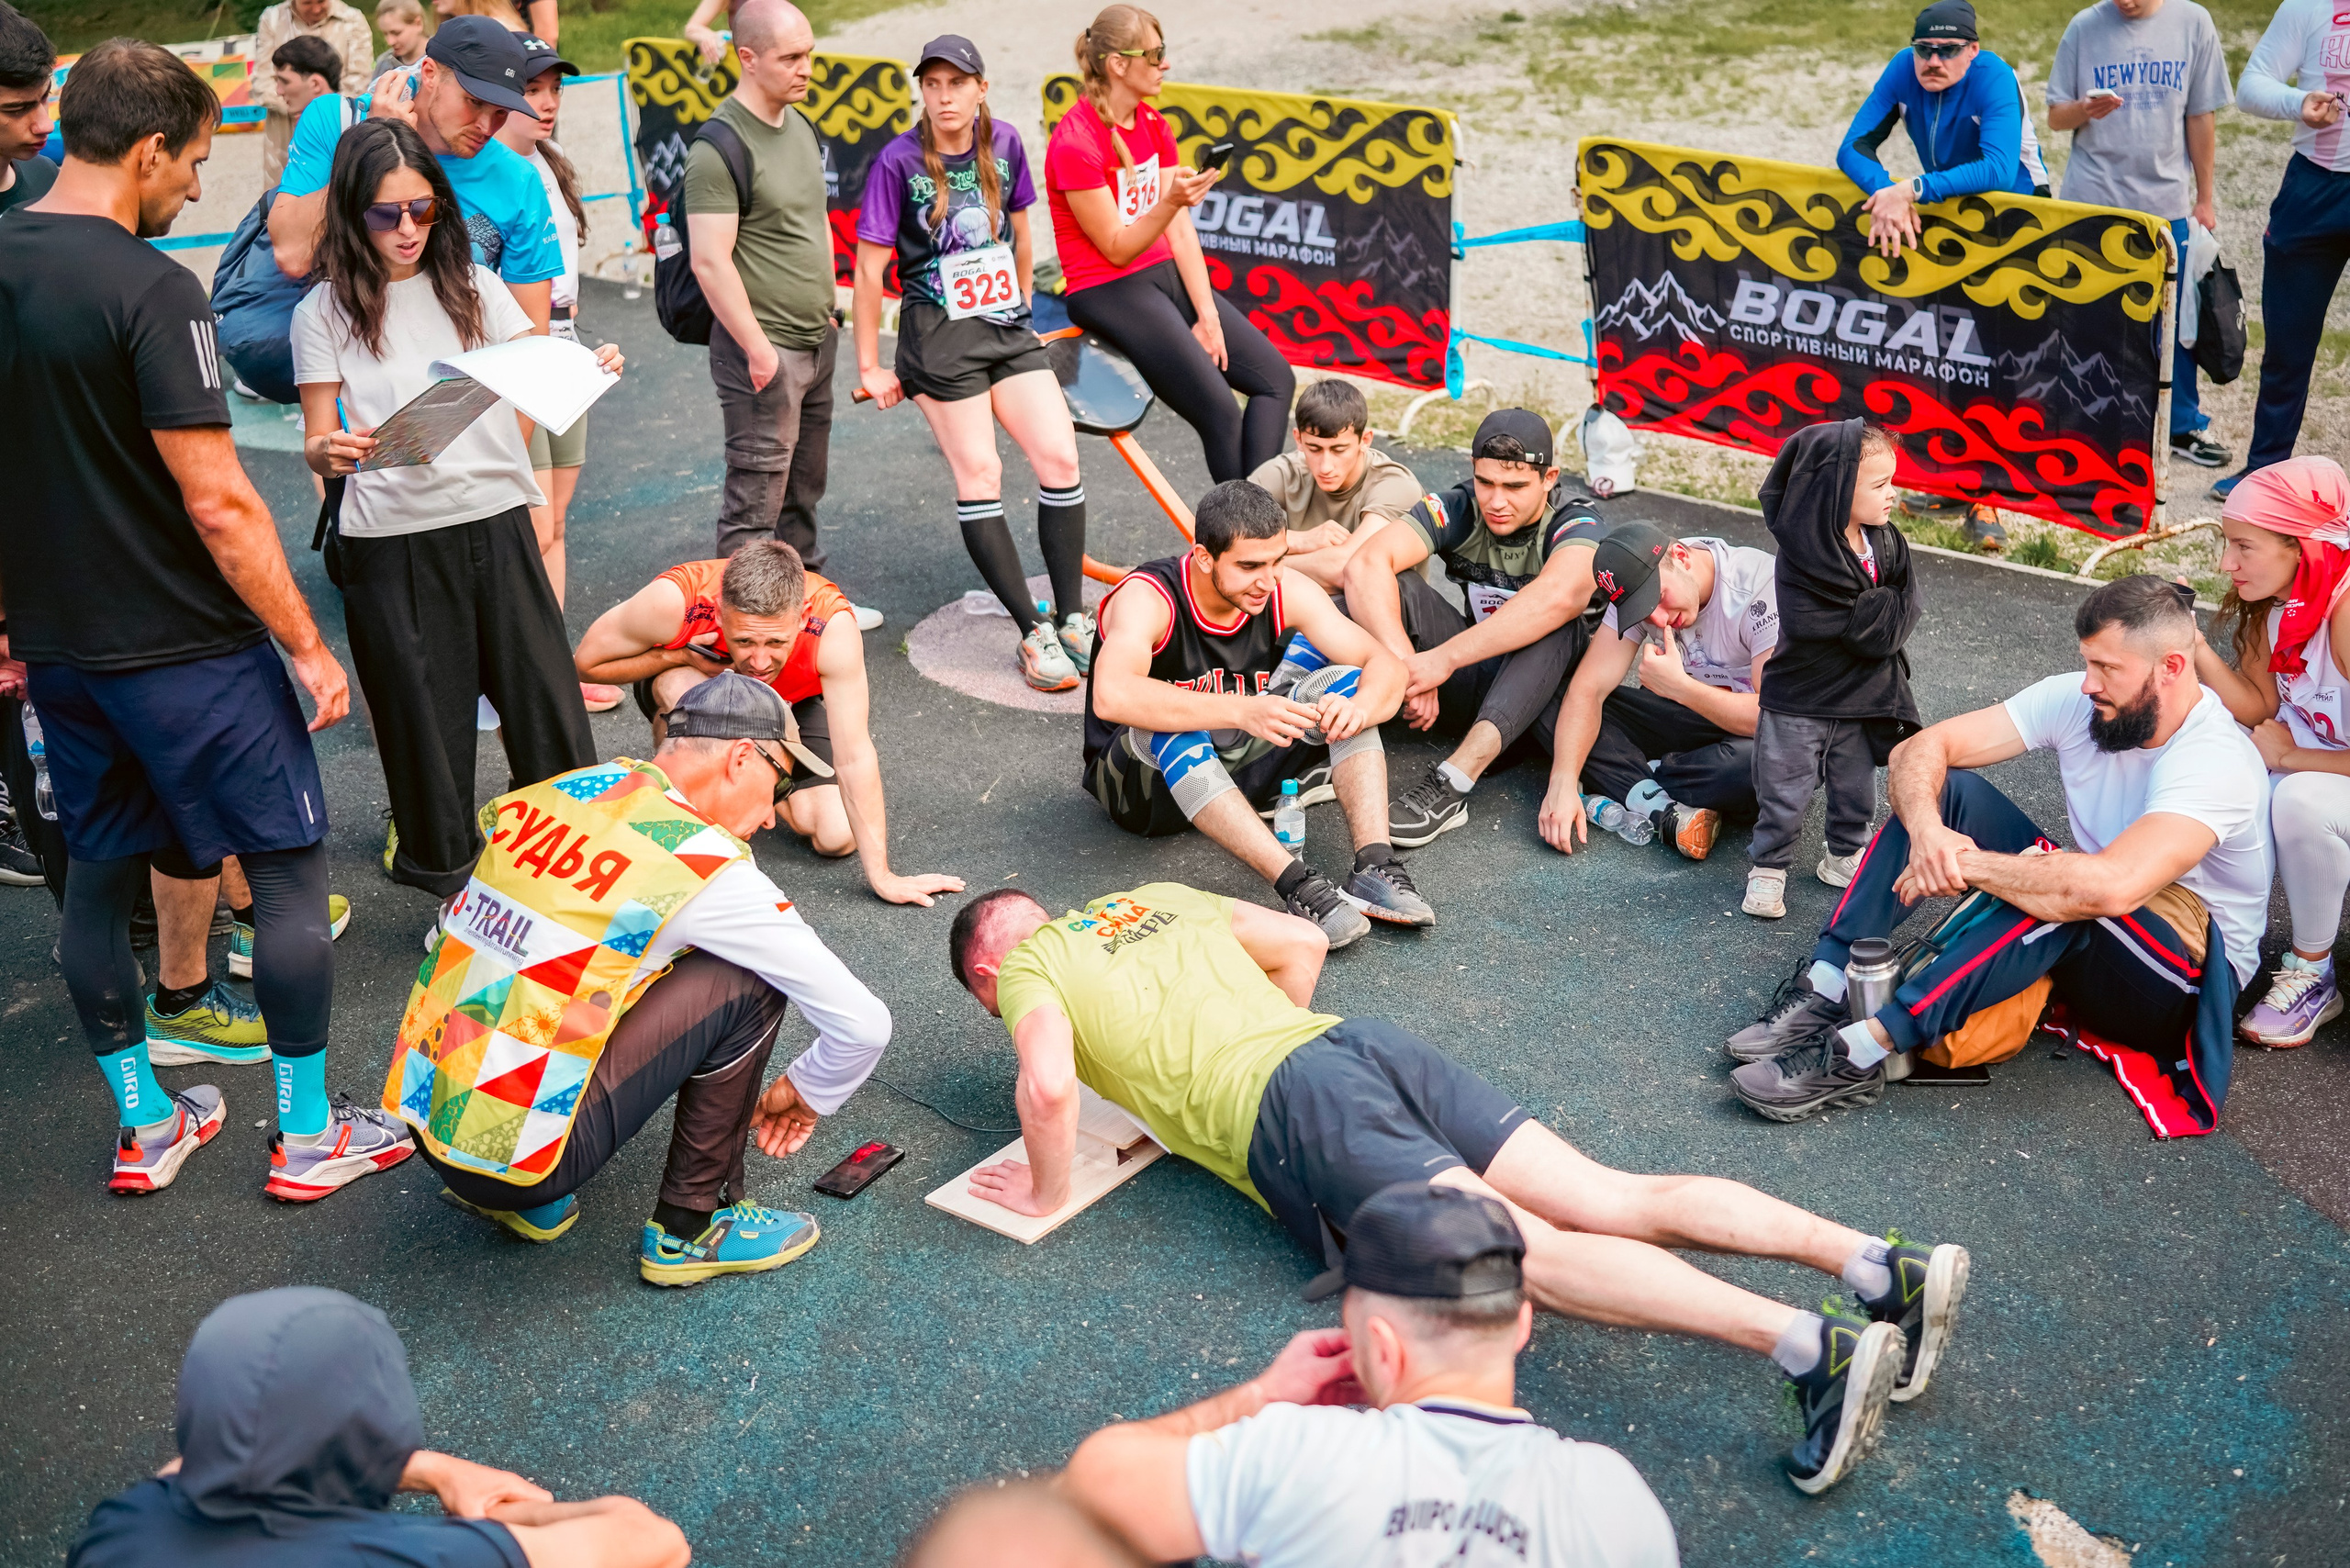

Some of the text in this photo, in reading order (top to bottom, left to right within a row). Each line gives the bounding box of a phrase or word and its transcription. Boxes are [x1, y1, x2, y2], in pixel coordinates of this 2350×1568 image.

[2093, 60, 2187, 92] NEWYORK
[2320, 35, 2350, 69] RU
[1126, 176, 1157, 217] 316
[1190, 190, 1337, 249] OGAL
[1199, 232, 1337, 267] ИВНЫЙ МАРАФОН
[954, 269, 1013, 310] 323
[1729, 278, 1991, 367] BOGAL
[1729, 324, 1990, 388] СПОРТИВНЫЙ МАРАФОН
[492, 800, 633, 903] СУДЬЯ
[120, 1057, 140, 1110] GIRO
[278, 1062, 294, 1114] GIRO
